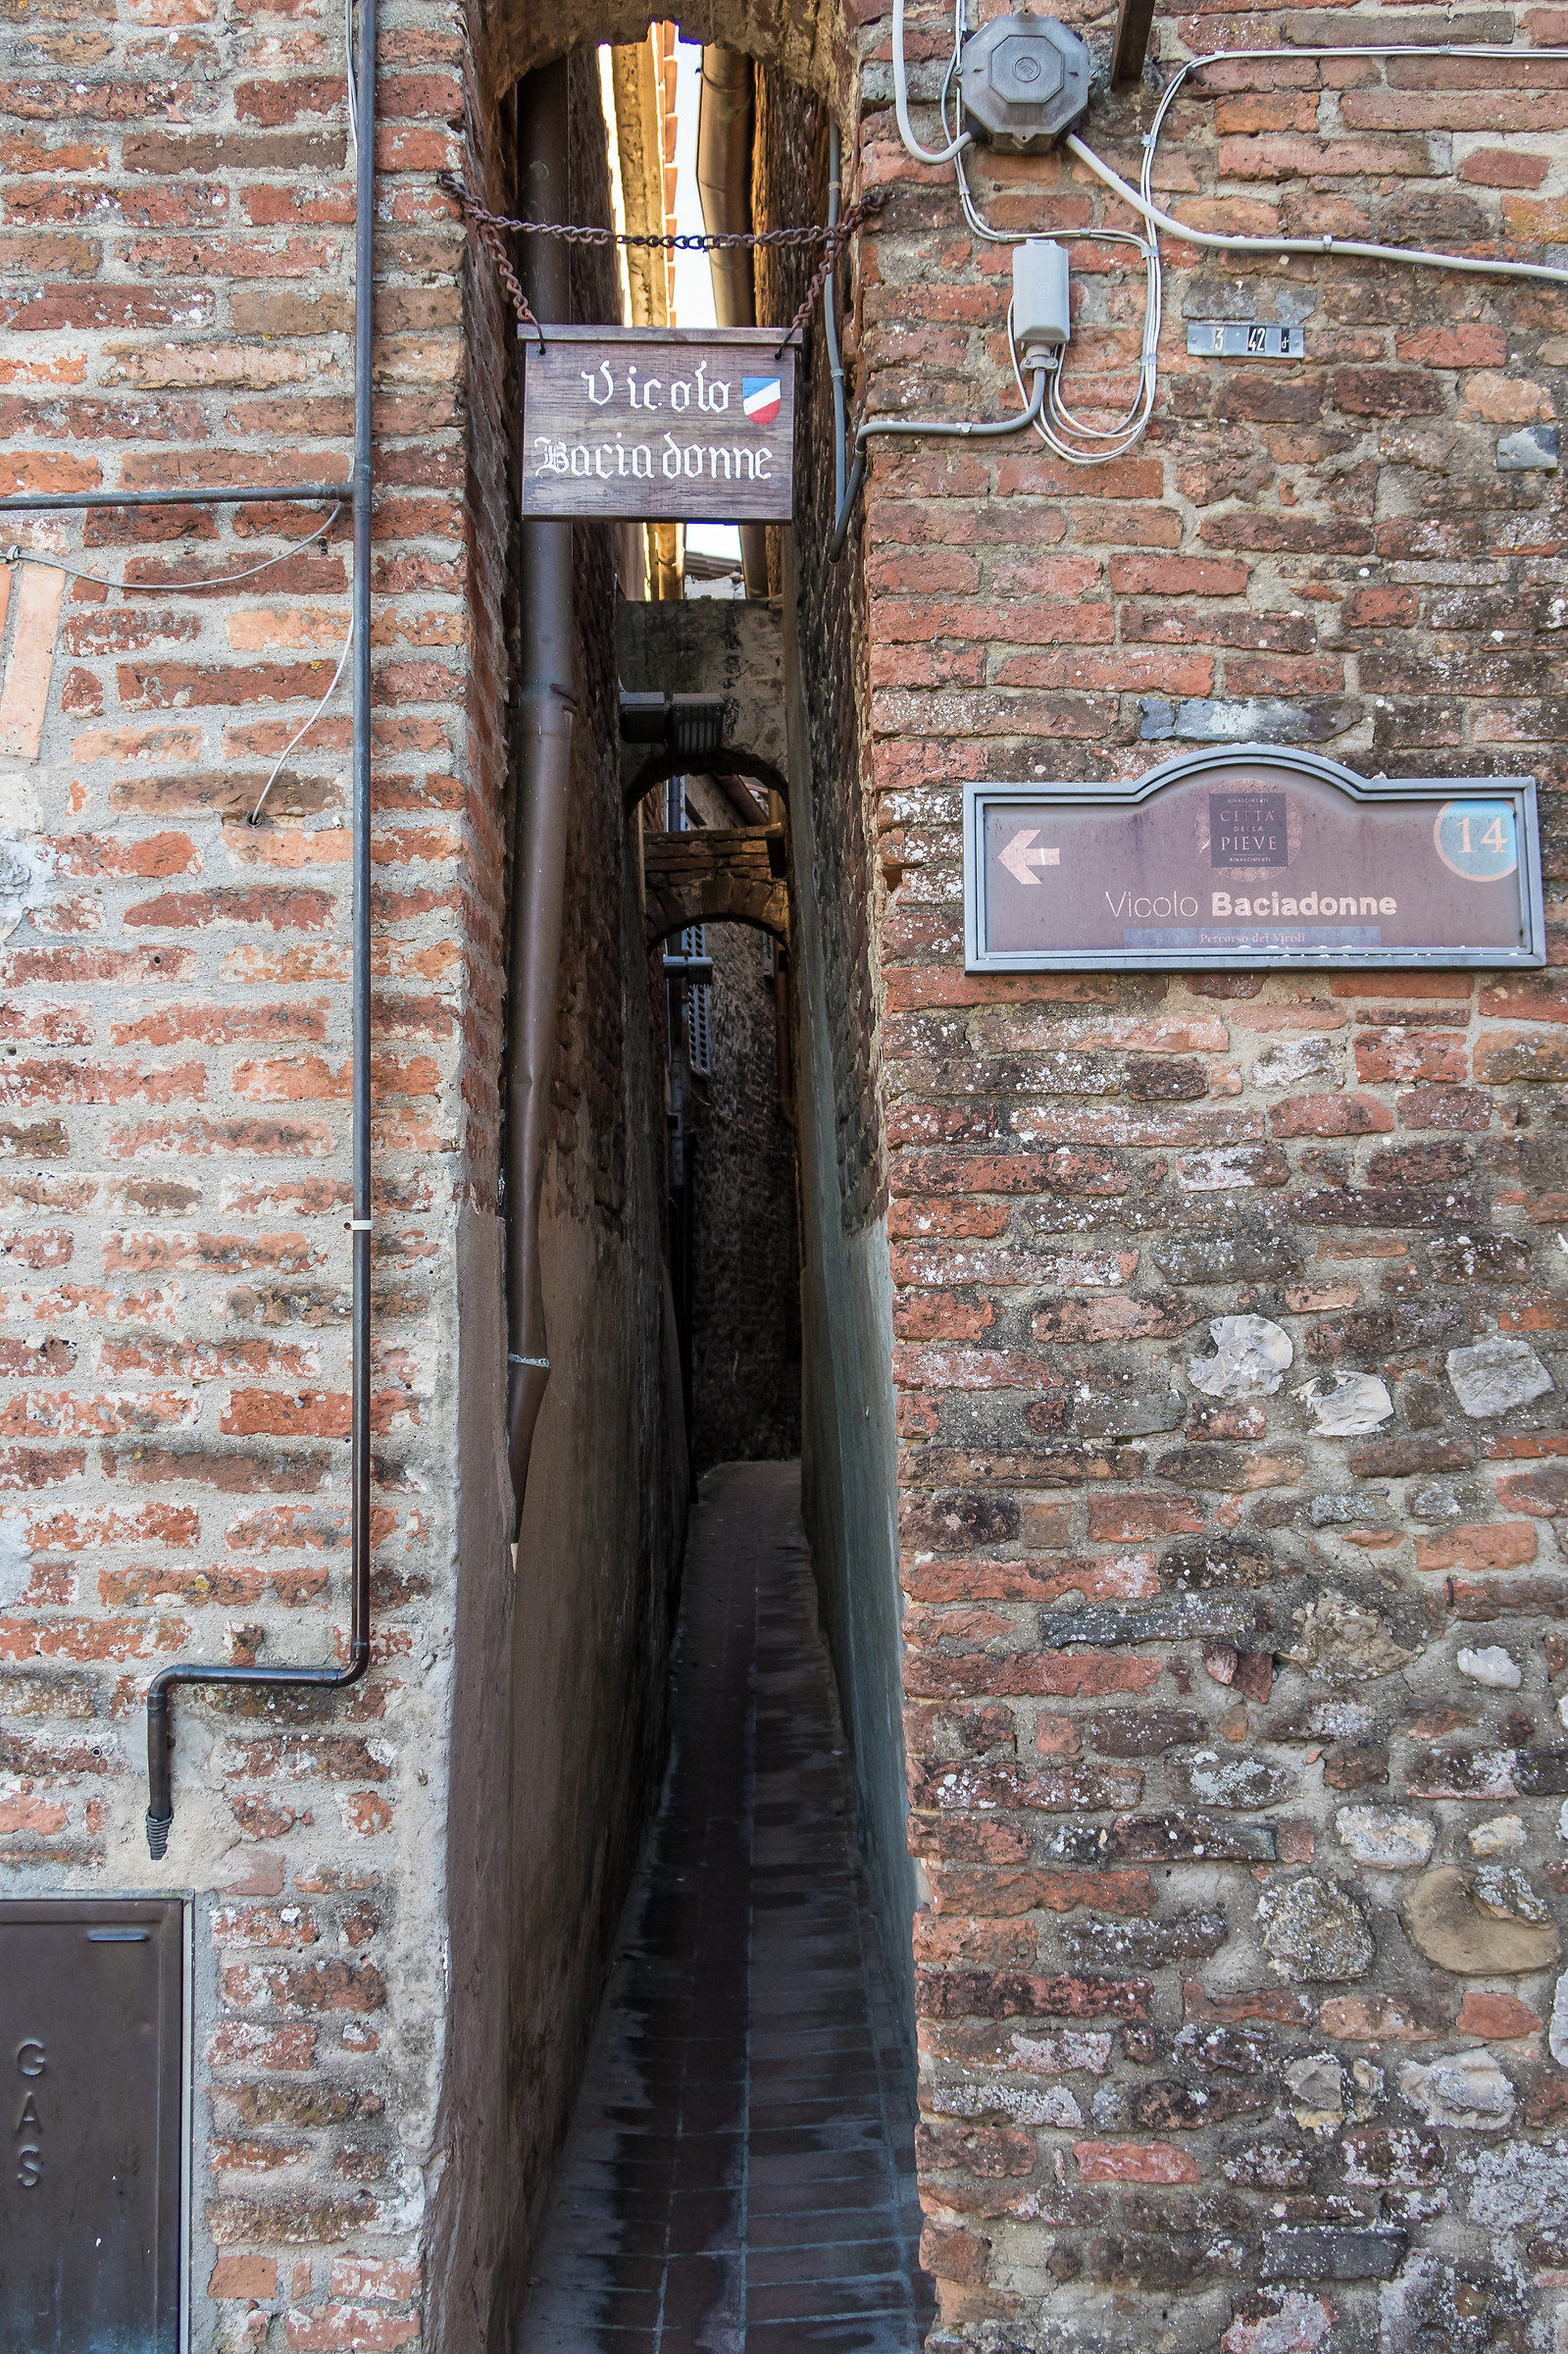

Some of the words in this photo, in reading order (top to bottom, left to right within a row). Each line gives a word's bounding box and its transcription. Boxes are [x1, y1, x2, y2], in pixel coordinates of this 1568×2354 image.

[1215, 328, 1224, 351] 3
[1248, 328, 1266, 351] 42
[581, 360, 732, 413] Vicolo
[1221, 836, 1277, 850] PIEVE
[1456, 816, 1508, 853] 14
[1105, 891, 1198, 918] Vicolo
[1211, 891, 1397, 917] Baciadonne
[1200, 933, 1249, 944] Percorso
[1251, 933, 1269, 943] dei
[1273, 933, 1305, 943] Vicoli
[16, 2037, 47, 2187] GAS
